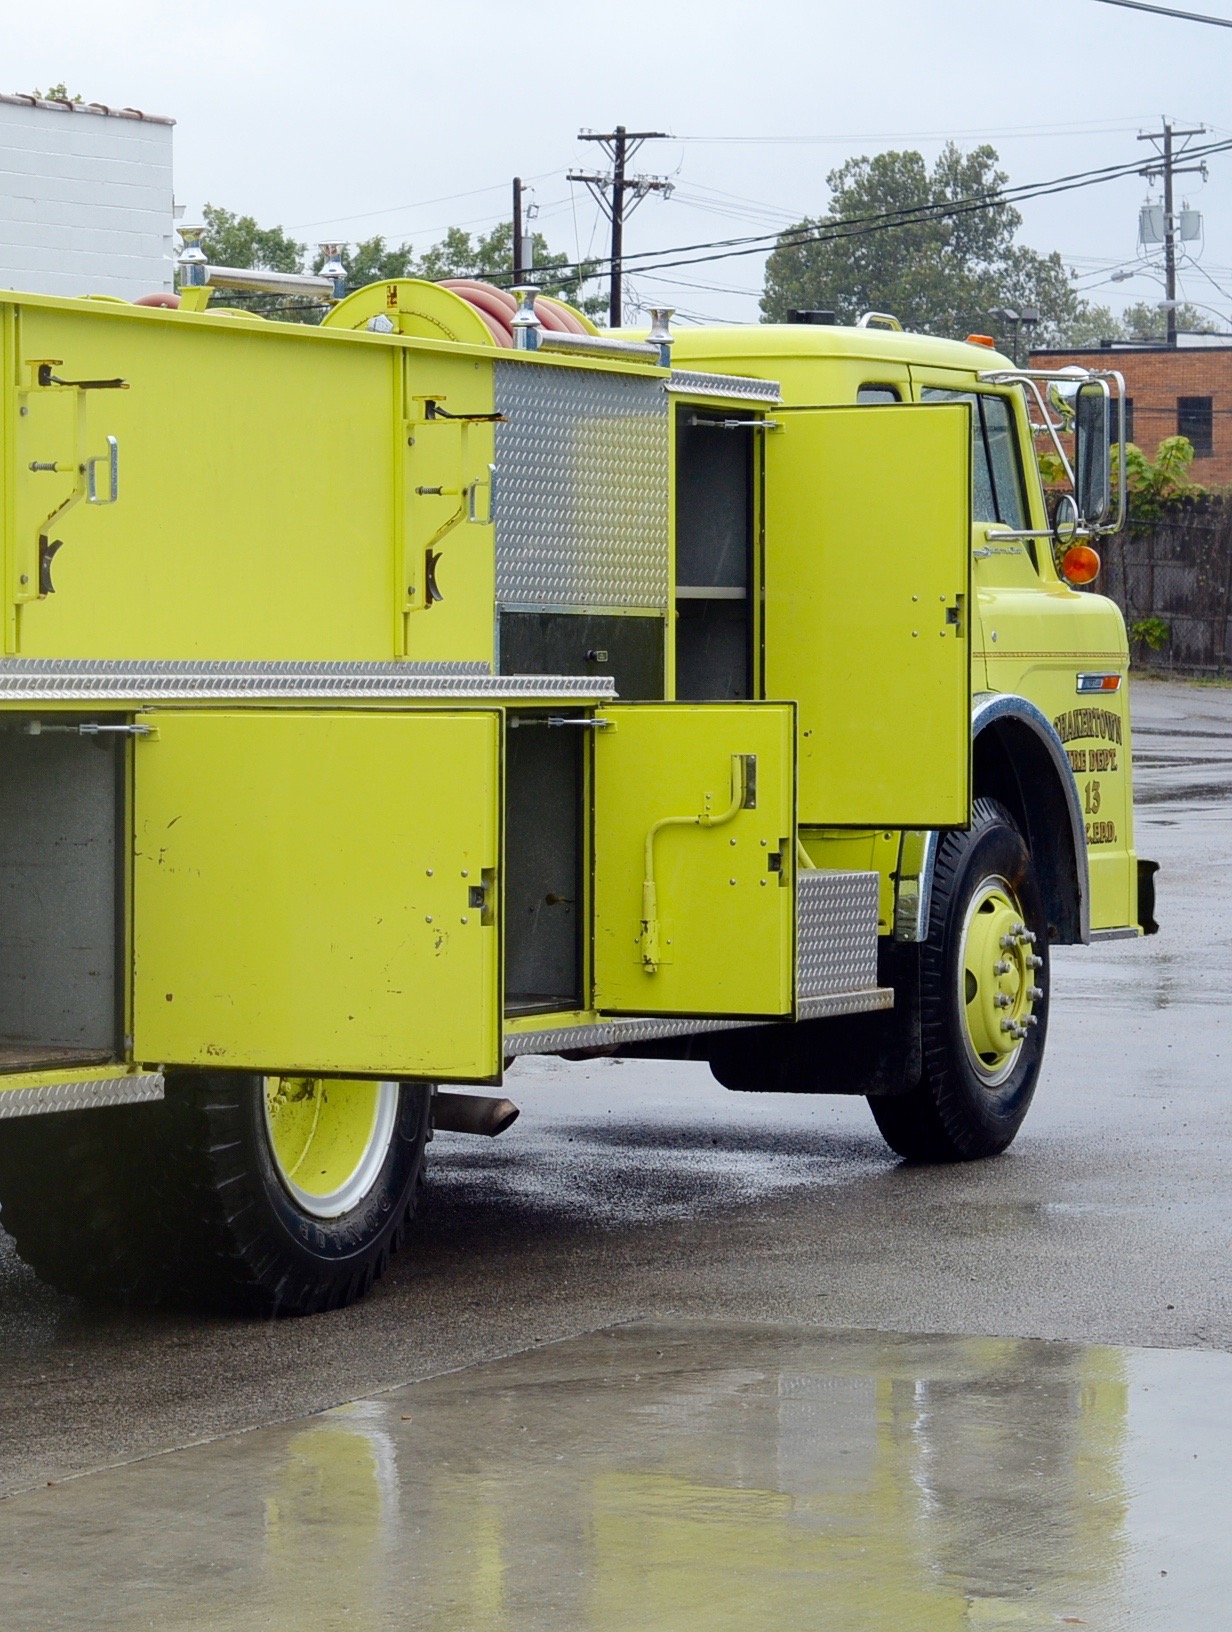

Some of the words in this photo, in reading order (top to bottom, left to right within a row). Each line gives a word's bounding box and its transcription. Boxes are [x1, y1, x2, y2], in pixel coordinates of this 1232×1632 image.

[1066, 749, 1086, 772] IRE
[1089, 748, 1118, 771] DEPT.
[298, 1187, 392, 1251] DUNLOP
